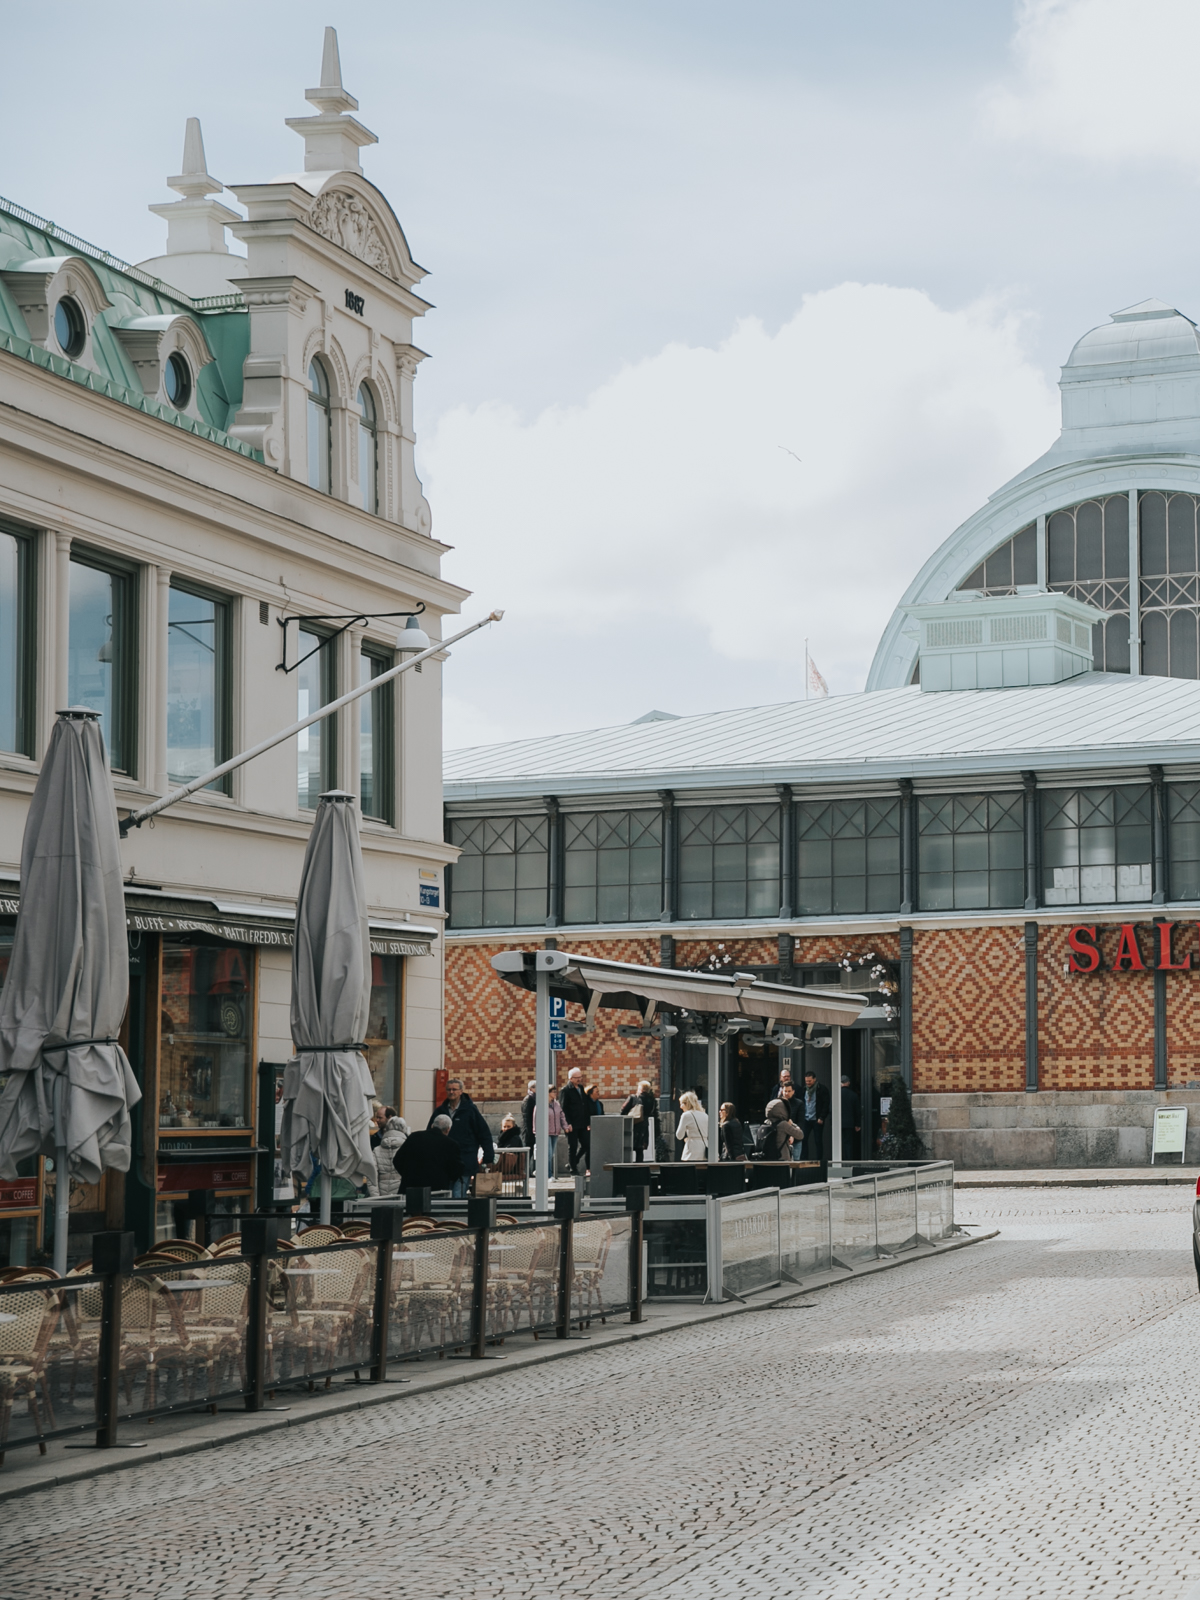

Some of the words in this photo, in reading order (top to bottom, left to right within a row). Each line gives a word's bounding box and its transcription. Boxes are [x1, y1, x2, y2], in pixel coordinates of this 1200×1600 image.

[553, 997, 562, 1016] P
[231, 1171, 248, 1181] COFFEE
[13, 1189, 34, 1200] COFFEE
[734, 1213, 769, 1239] ALDARDO
